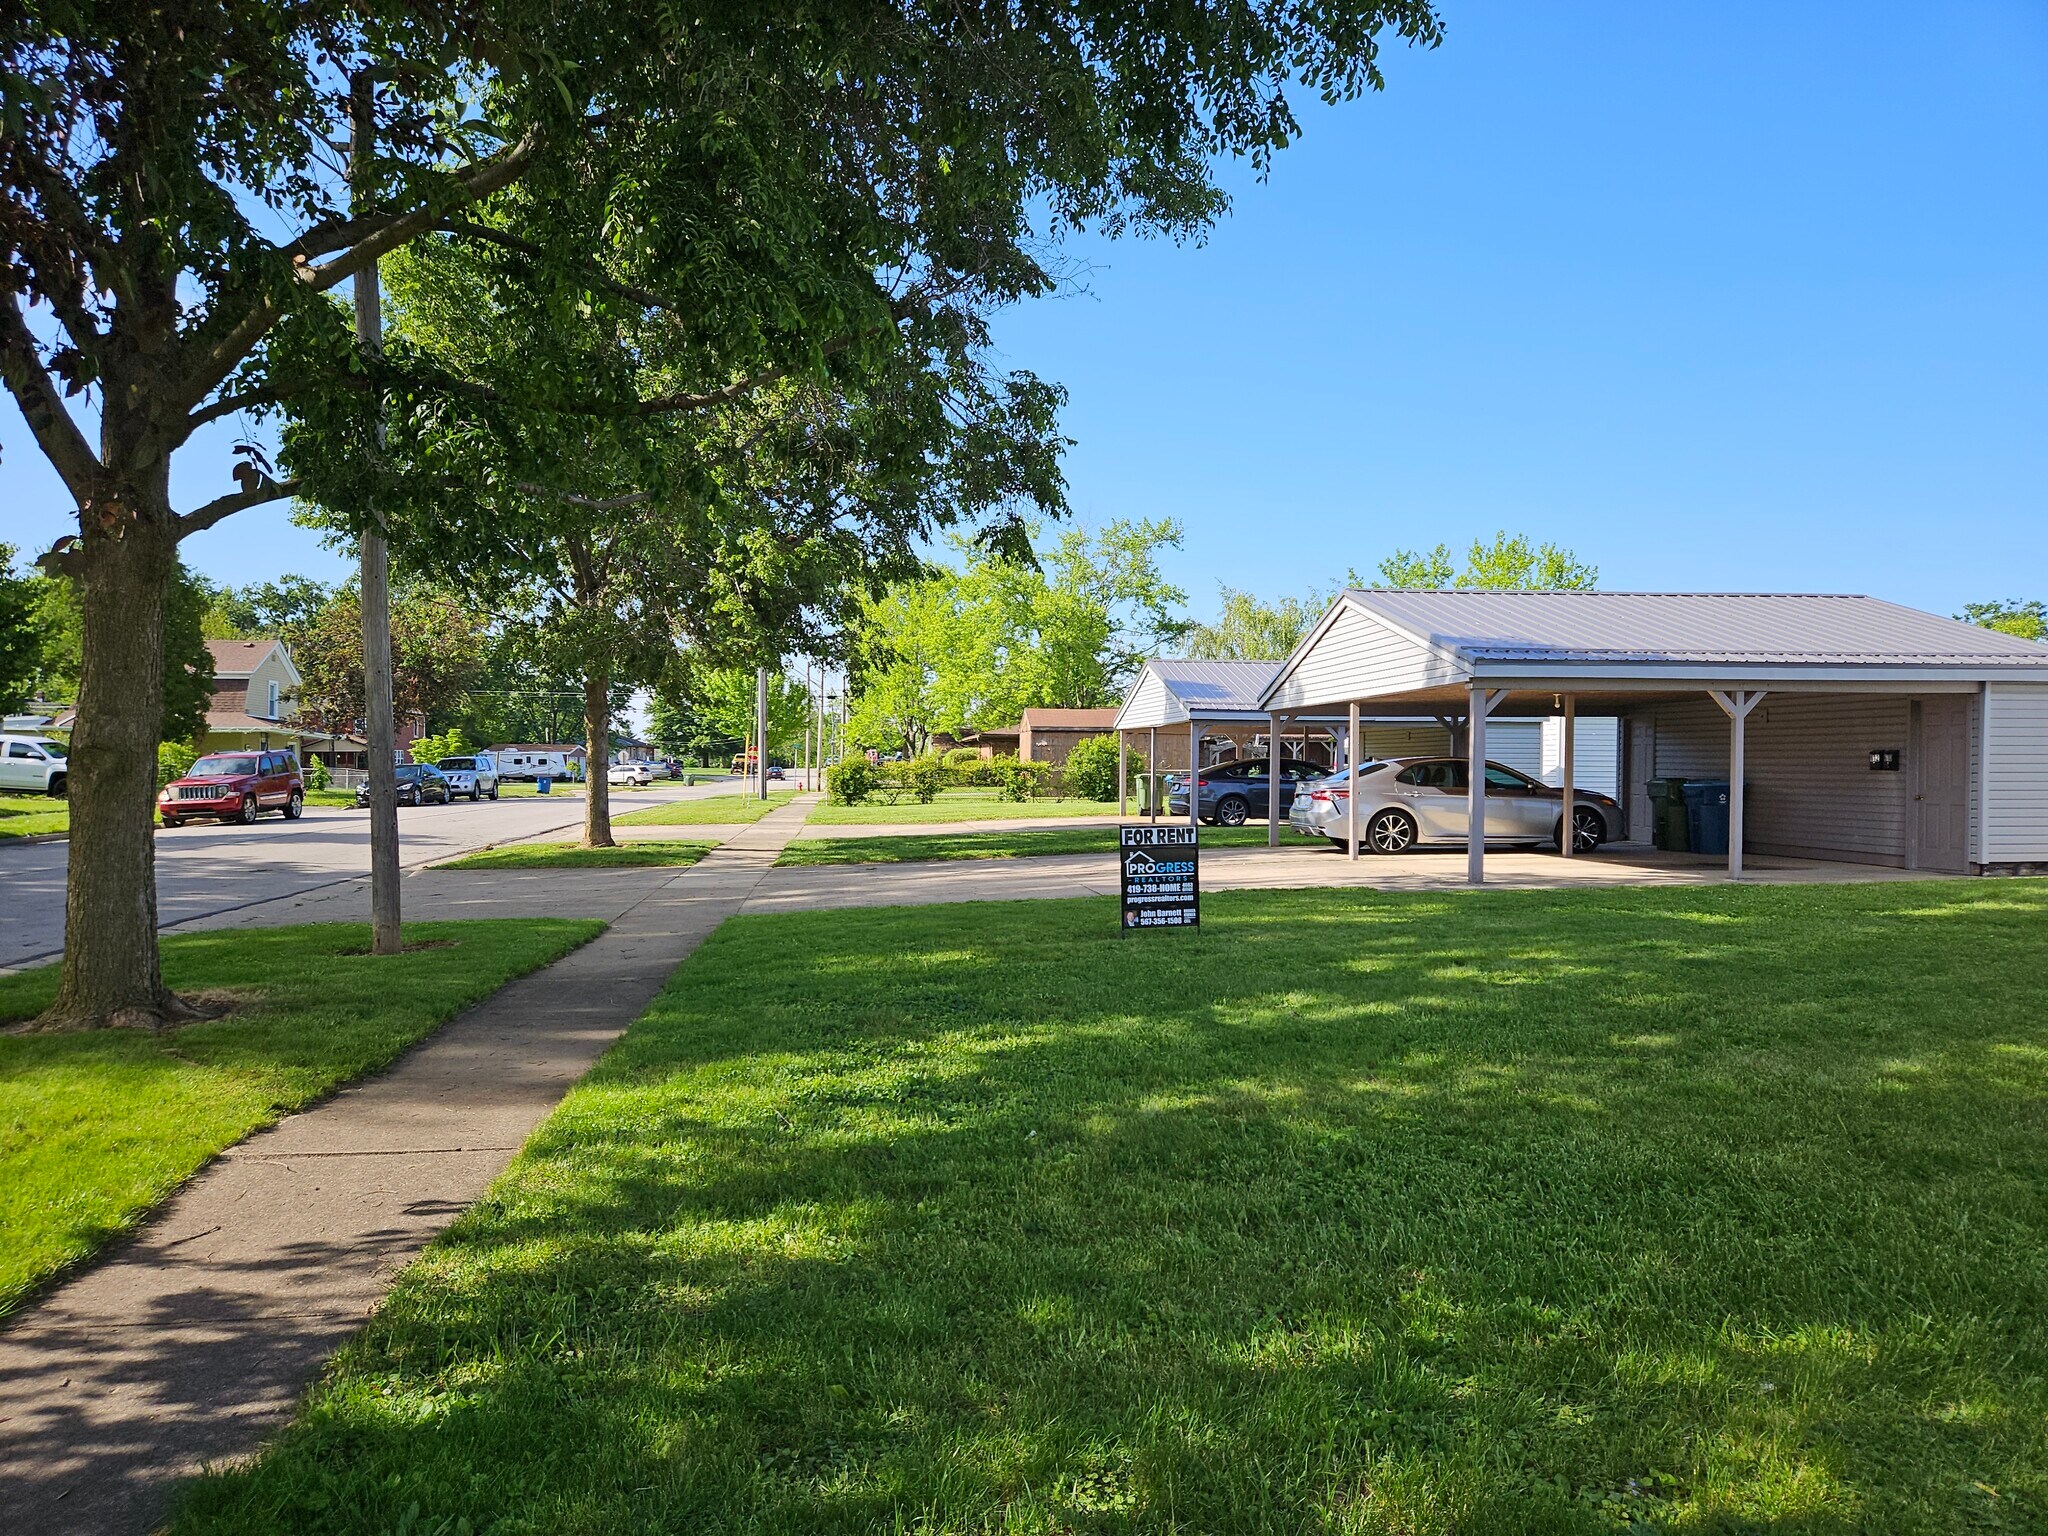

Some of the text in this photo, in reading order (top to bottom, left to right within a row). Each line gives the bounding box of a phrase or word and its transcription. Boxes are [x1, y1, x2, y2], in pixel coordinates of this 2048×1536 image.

[1124, 828, 1194, 845] FOR RENT
[1129, 861, 1195, 874] PROGRESS
[1134, 875, 1188, 883] REALTORS
[1127, 883, 1181, 893] 419-738-HOME
[1127, 894, 1194, 904] progressrealtors.com
[1140, 909, 1156, 918] John
